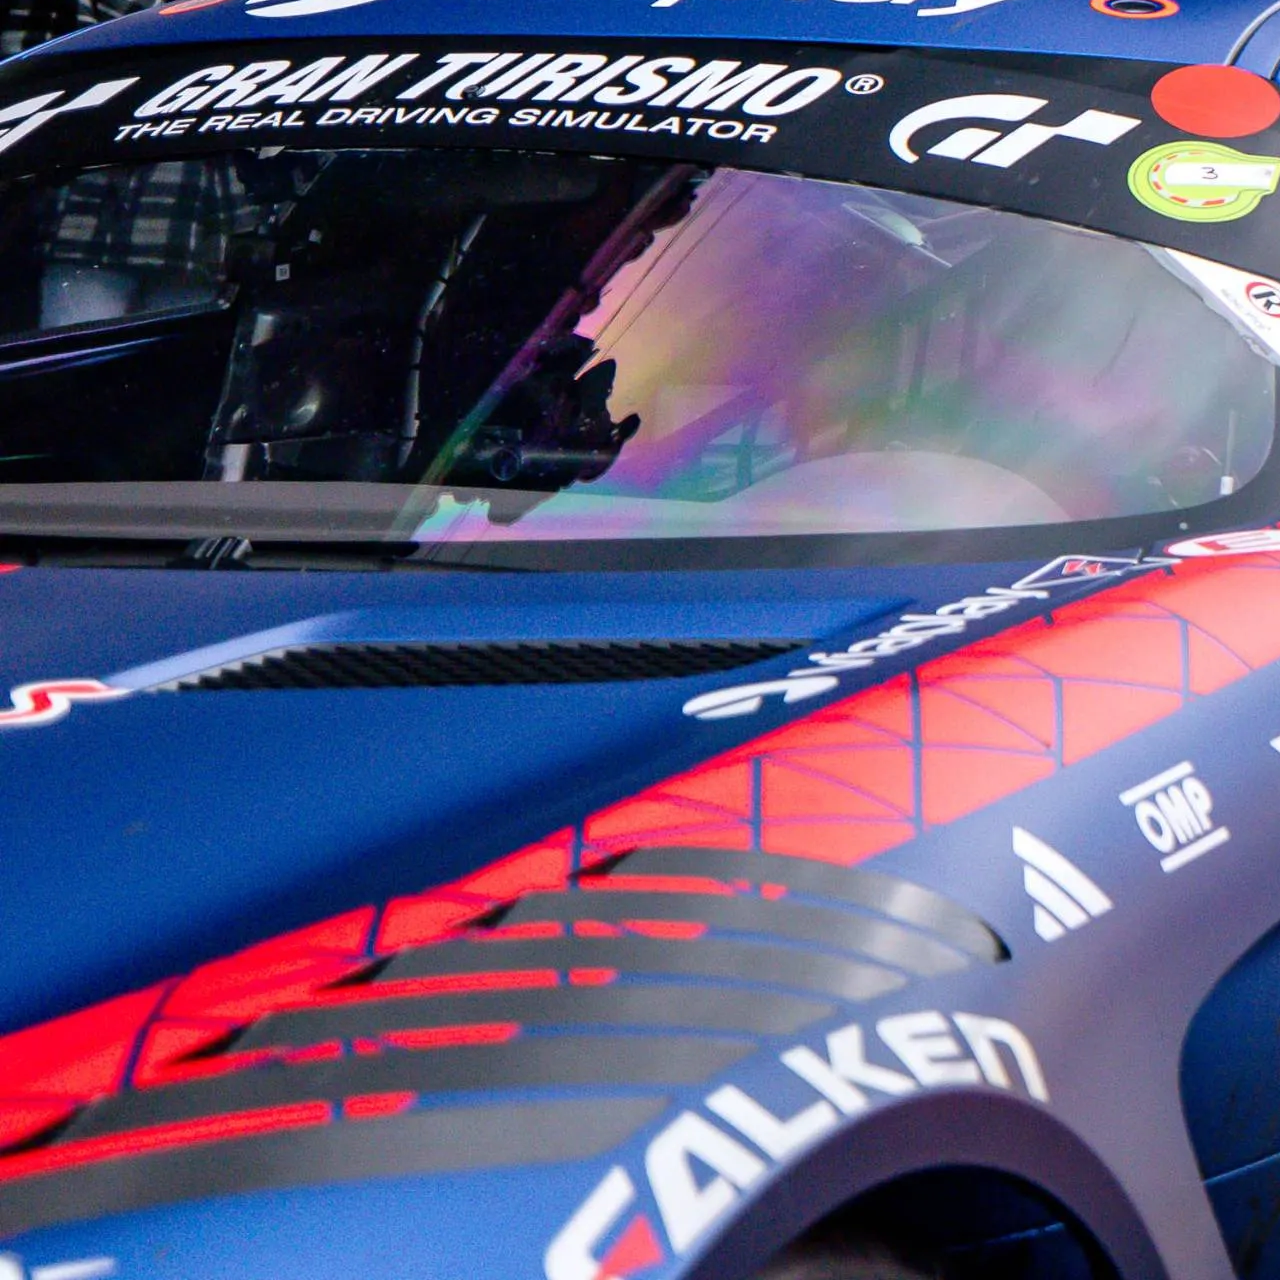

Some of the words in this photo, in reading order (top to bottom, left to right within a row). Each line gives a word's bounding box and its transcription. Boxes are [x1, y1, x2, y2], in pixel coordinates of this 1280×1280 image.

[133, 53, 419, 118] GRAN
[114, 122, 192, 144] THE
[199, 112, 315, 138] REAL
[320, 105, 500, 128] DRIVING
[508, 107, 779, 145] SIMULATOR
[1134, 782, 1214, 854] OMP
